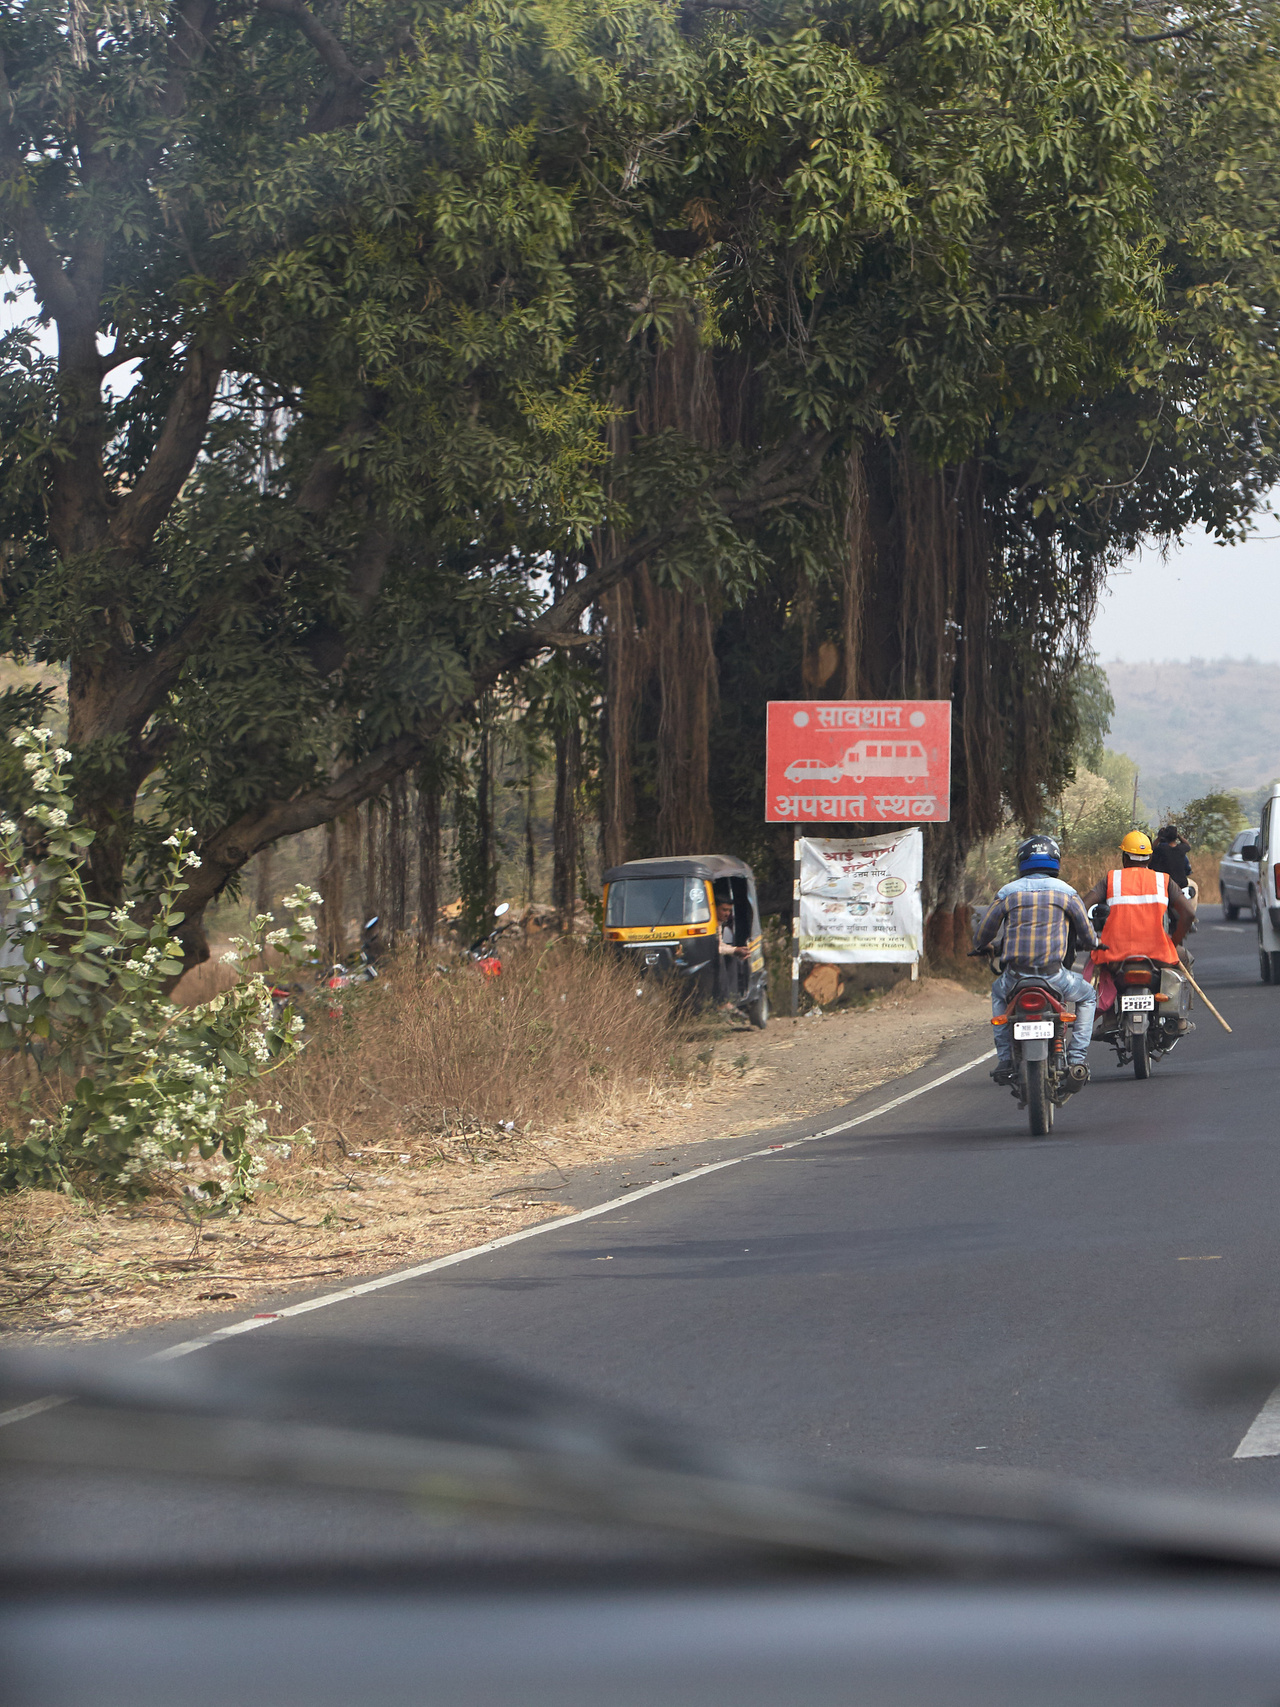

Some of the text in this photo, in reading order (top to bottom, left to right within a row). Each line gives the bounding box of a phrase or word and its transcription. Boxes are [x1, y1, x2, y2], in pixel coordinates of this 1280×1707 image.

[815, 706, 903, 728] सावधान
[773, 795, 937, 818] अपघात स्थळ
